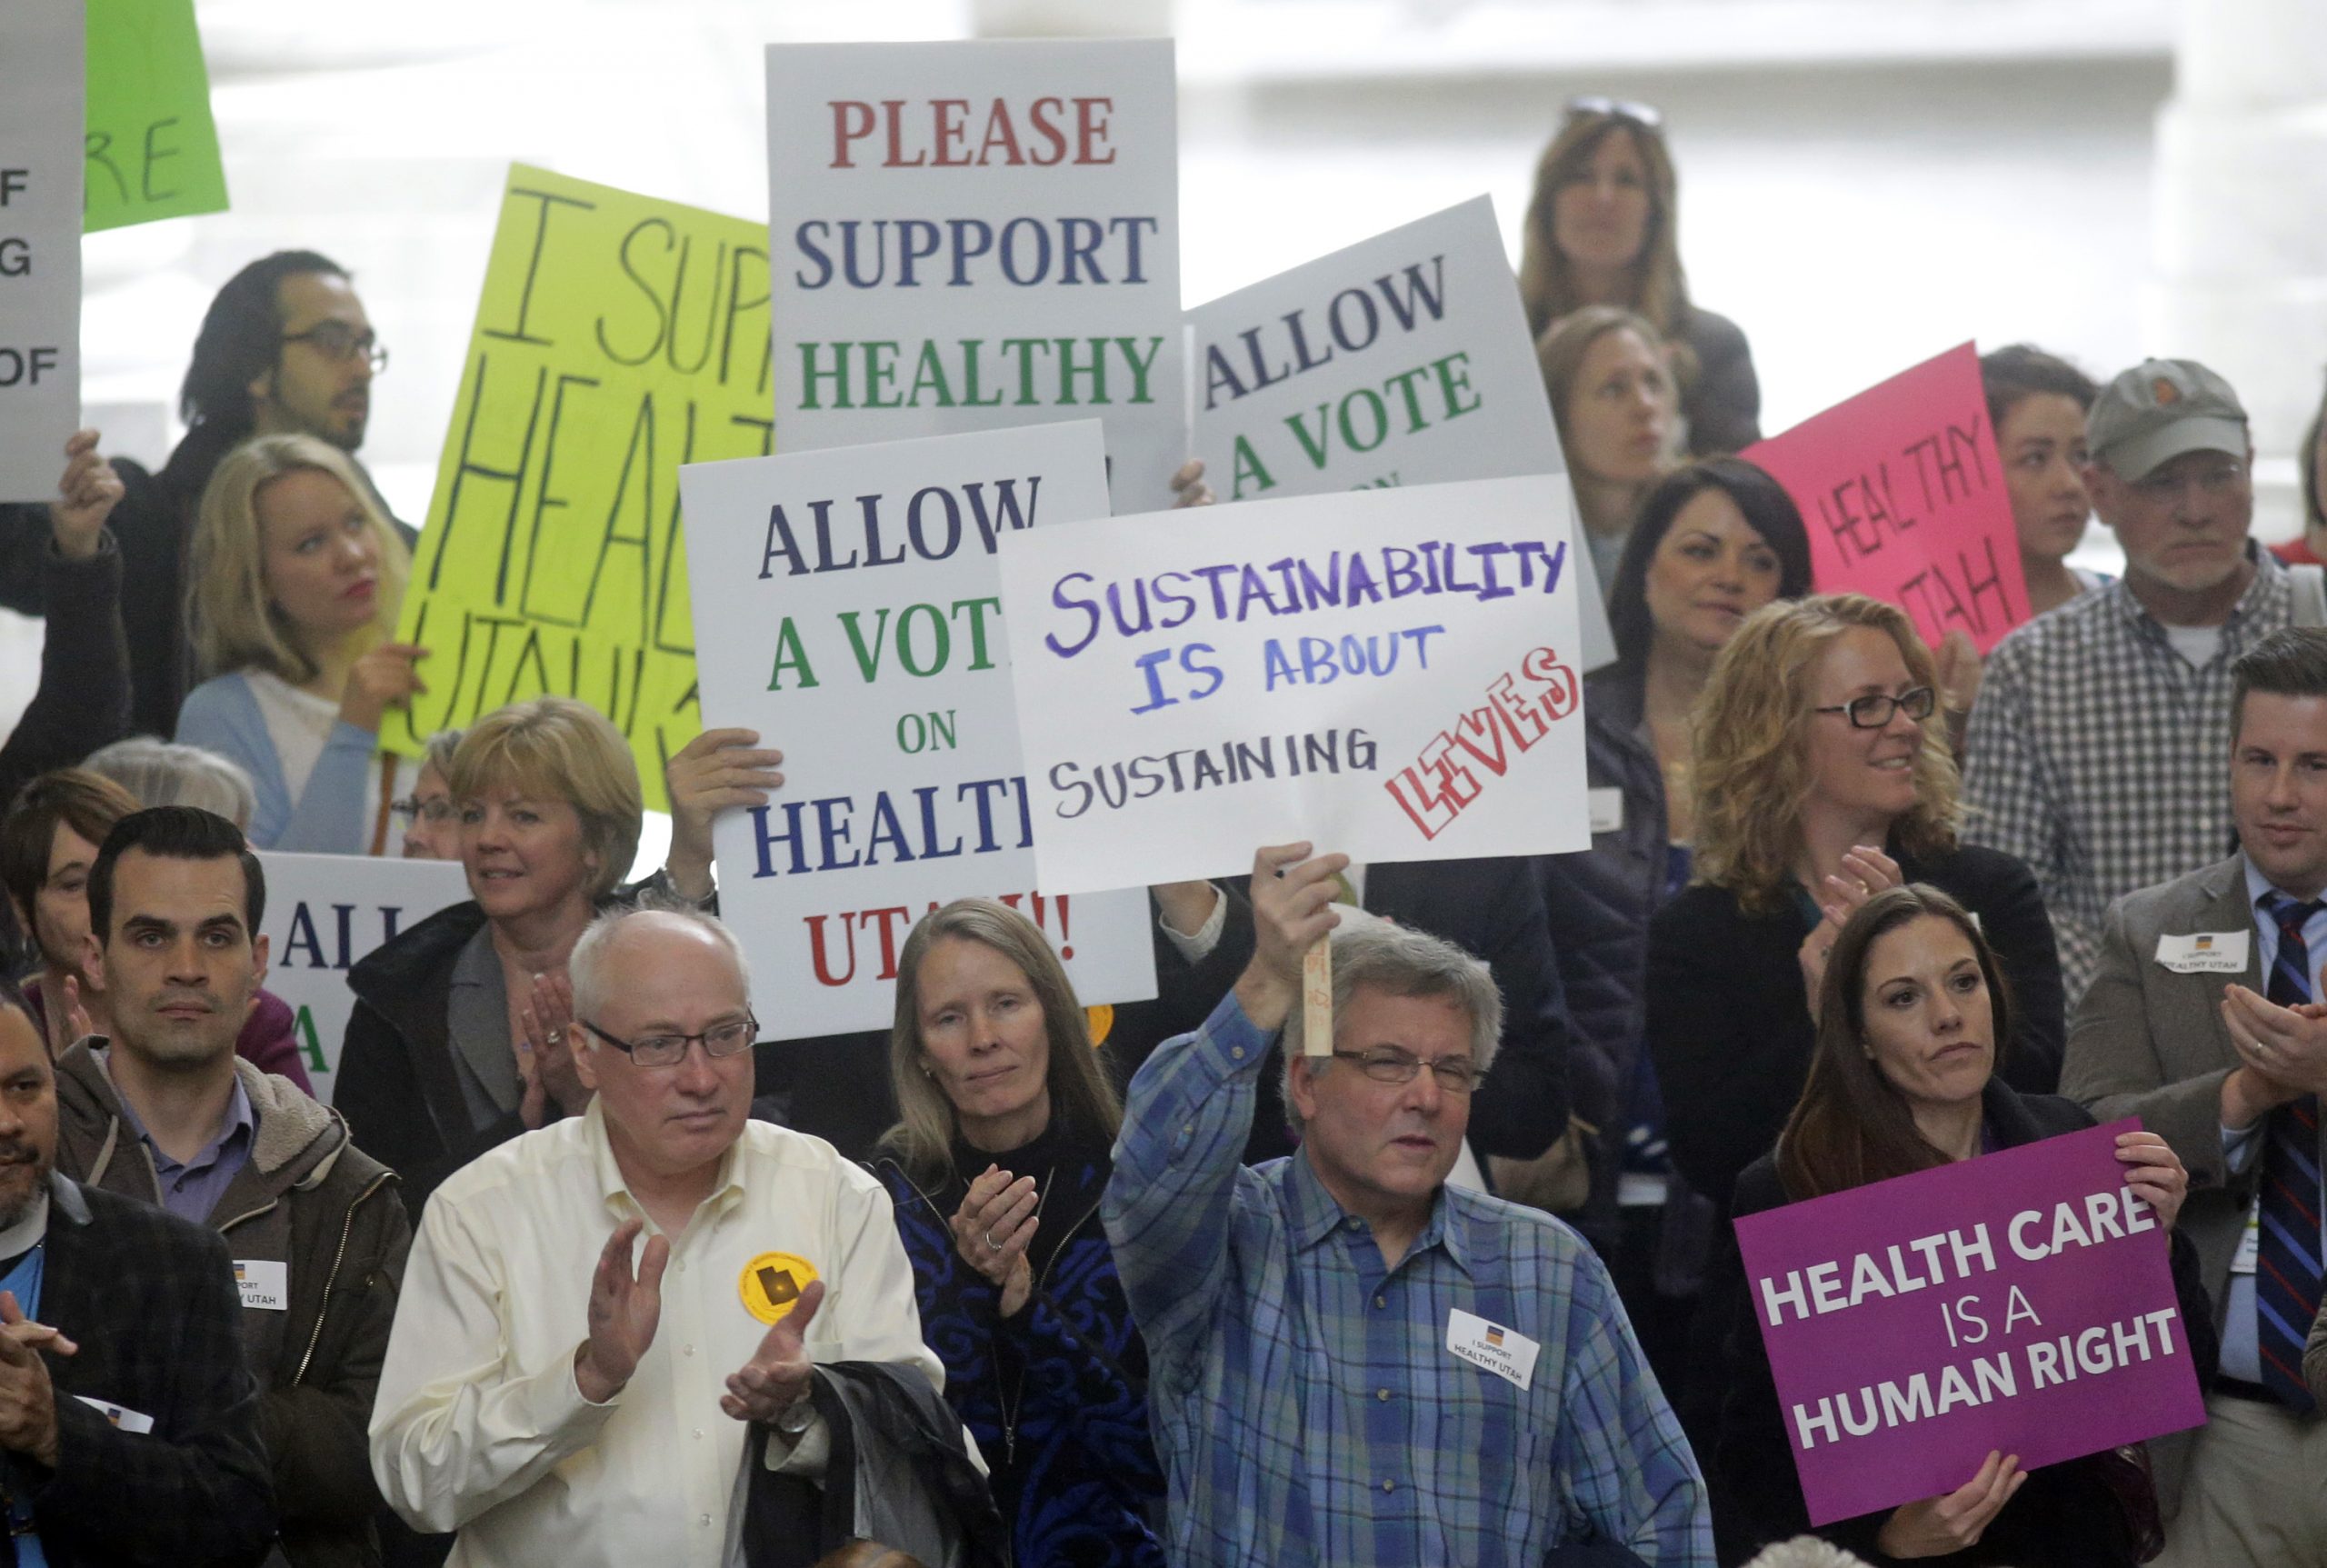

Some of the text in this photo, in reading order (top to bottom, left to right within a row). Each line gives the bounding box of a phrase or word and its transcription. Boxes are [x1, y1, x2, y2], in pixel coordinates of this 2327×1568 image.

[829, 97, 1117, 169] PLEASE
[482, 186, 772, 395] I SUP
[794, 215, 1158, 291] SUPPORT
[796, 335, 1165, 411] HEALTHY
[1204, 255, 1445, 411] ALLOW
[1231, 350, 1483, 500] A VOTE
[427, 352, 774, 659] HEAL
[757, 475, 1043, 580] ALLOW
[1818, 412, 1989, 570] HEALTHY
[1044, 540, 1567, 659] SUSTAINABILITY
[1898, 535, 2015, 635] TAH
[766, 596, 1003, 692] A VOT
[1130, 624, 1445, 716] IS ABOUT
[895, 709, 958, 754] ON
[1049, 646, 1580, 842] SUSTAINING LIVES
[1760, 1185, 2156, 1326] HEALTH CARE
[1453, 1343, 1523, 1382] HEALTHY UTAH
[1476, 1341, 1513, 1361] SUPPORT
[1941, 1284, 2042, 1348] IS A
[1792, 1307, 2177, 1450] HUMAN RIGHT
